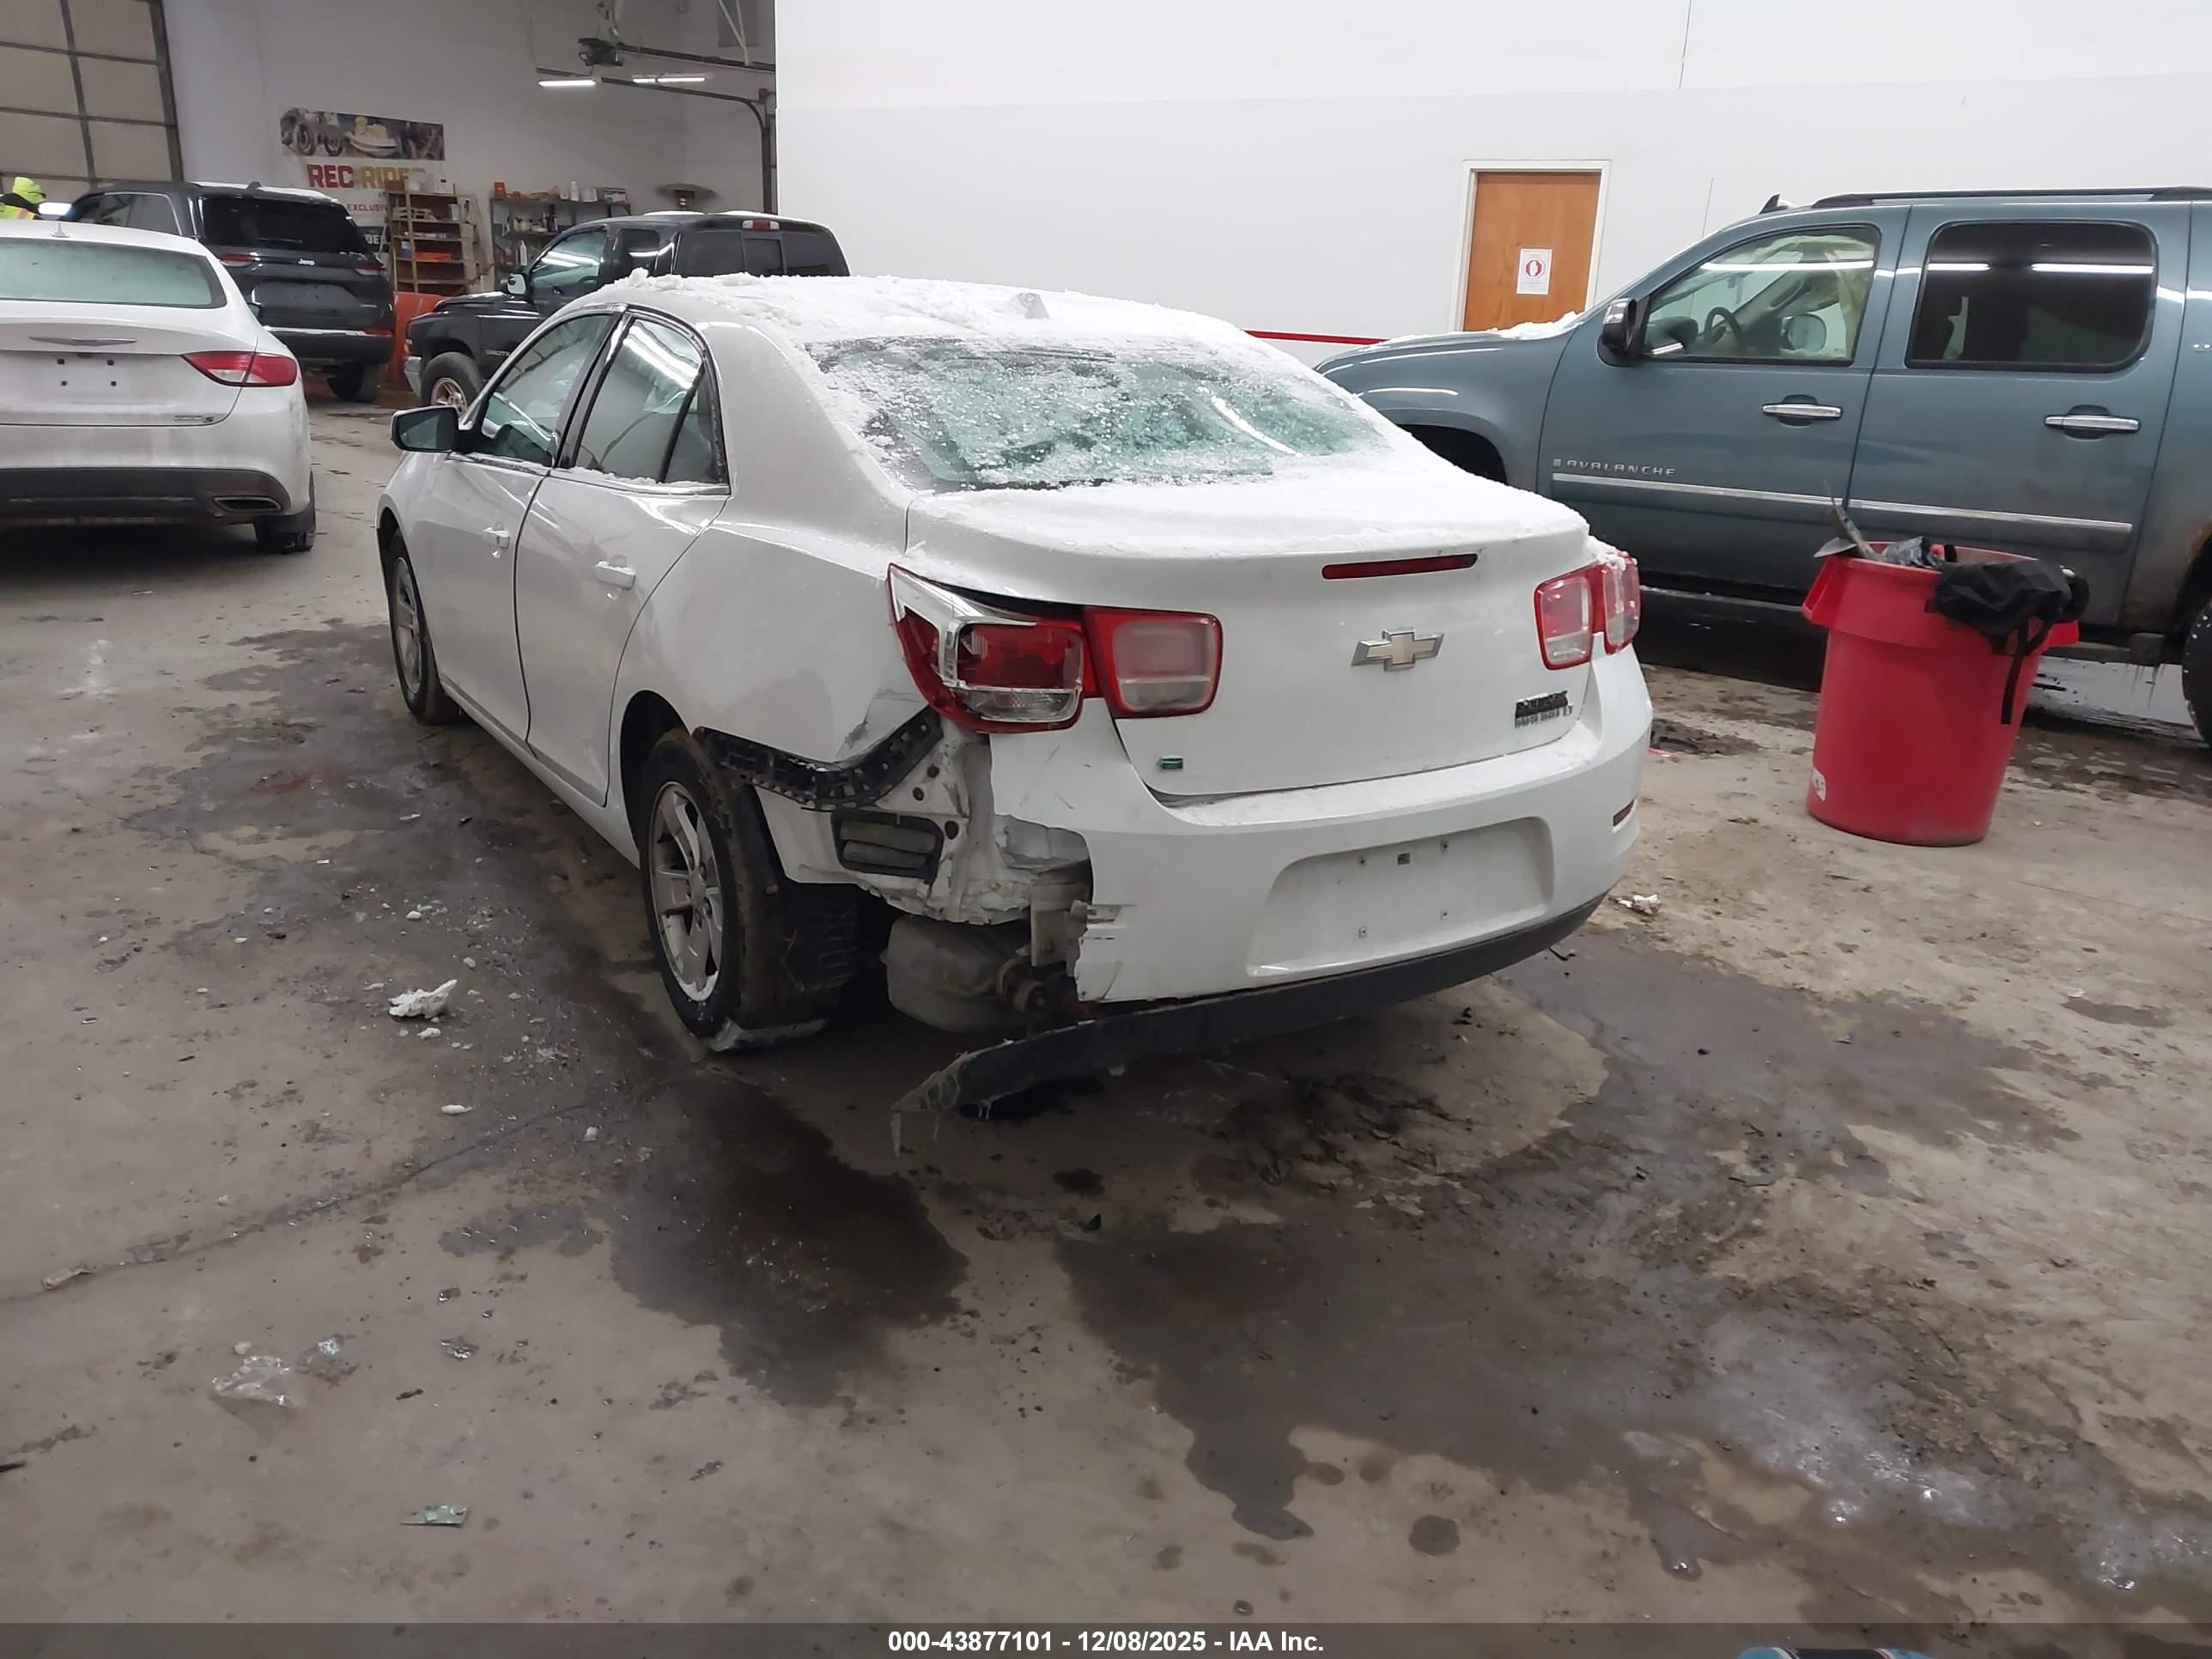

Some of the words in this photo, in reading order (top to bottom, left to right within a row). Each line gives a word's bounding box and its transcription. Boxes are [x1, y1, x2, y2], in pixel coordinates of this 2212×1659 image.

[307, 164, 354, 188] REC
[360, 166, 425, 189] RID
[1567, 459, 1675, 477] AVALANCHE
